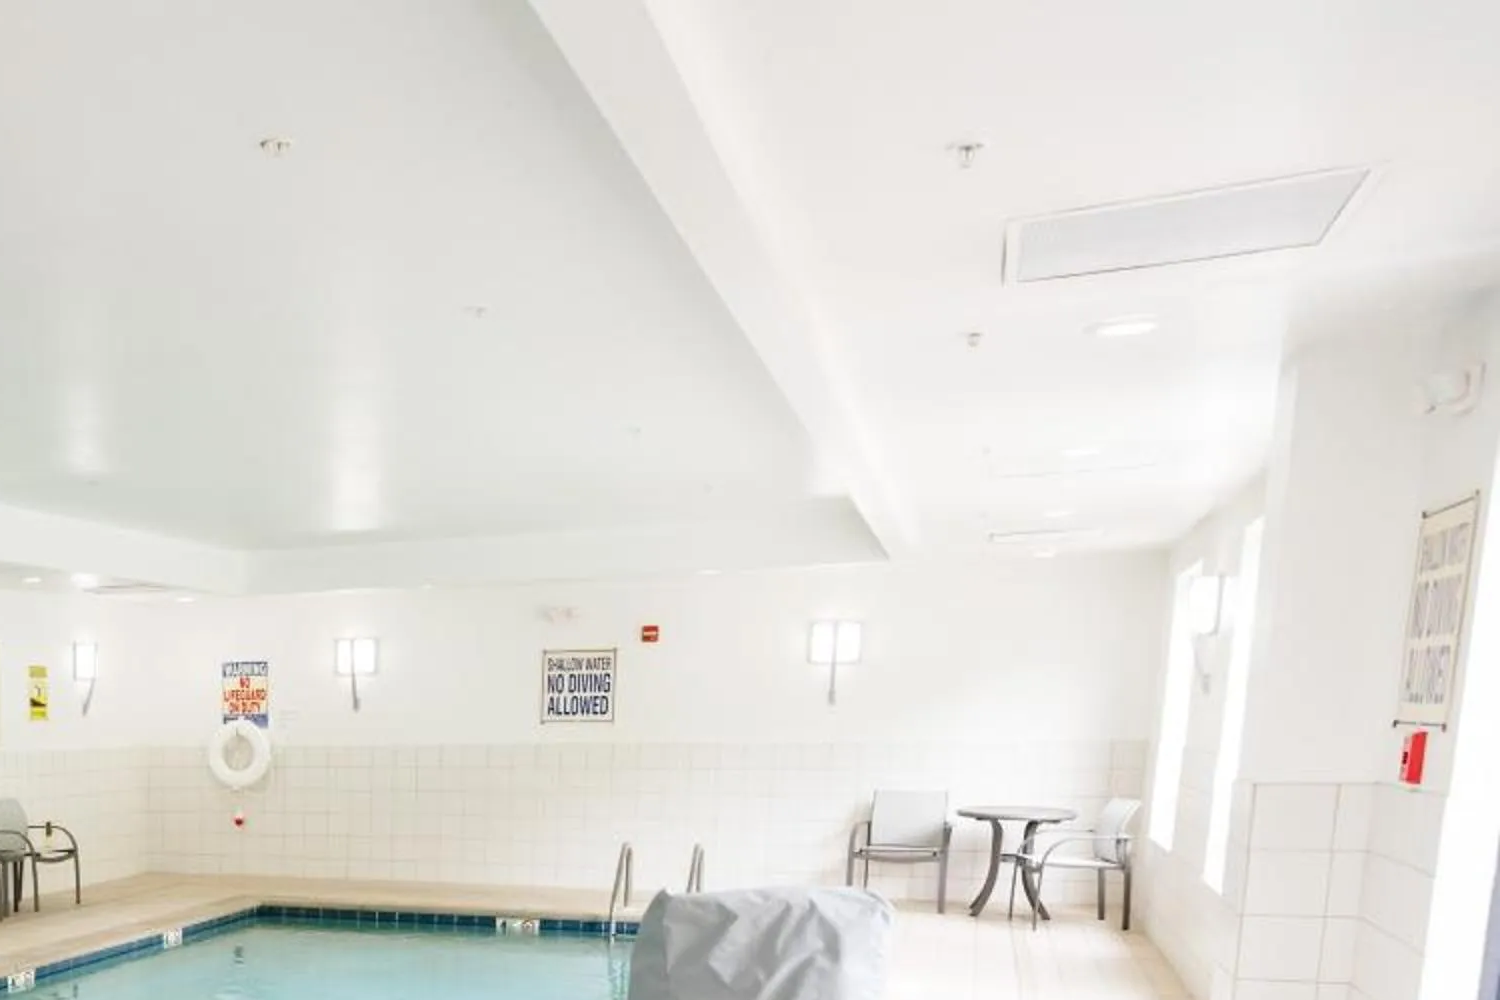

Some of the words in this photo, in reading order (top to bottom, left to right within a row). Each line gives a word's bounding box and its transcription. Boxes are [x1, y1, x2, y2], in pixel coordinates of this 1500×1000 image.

[584, 656, 612, 671] WATER
[547, 673, 565, 693] NO
[568, 673, 611, 693] DIVING
[547, 695, 609, 715] ALLOWED
